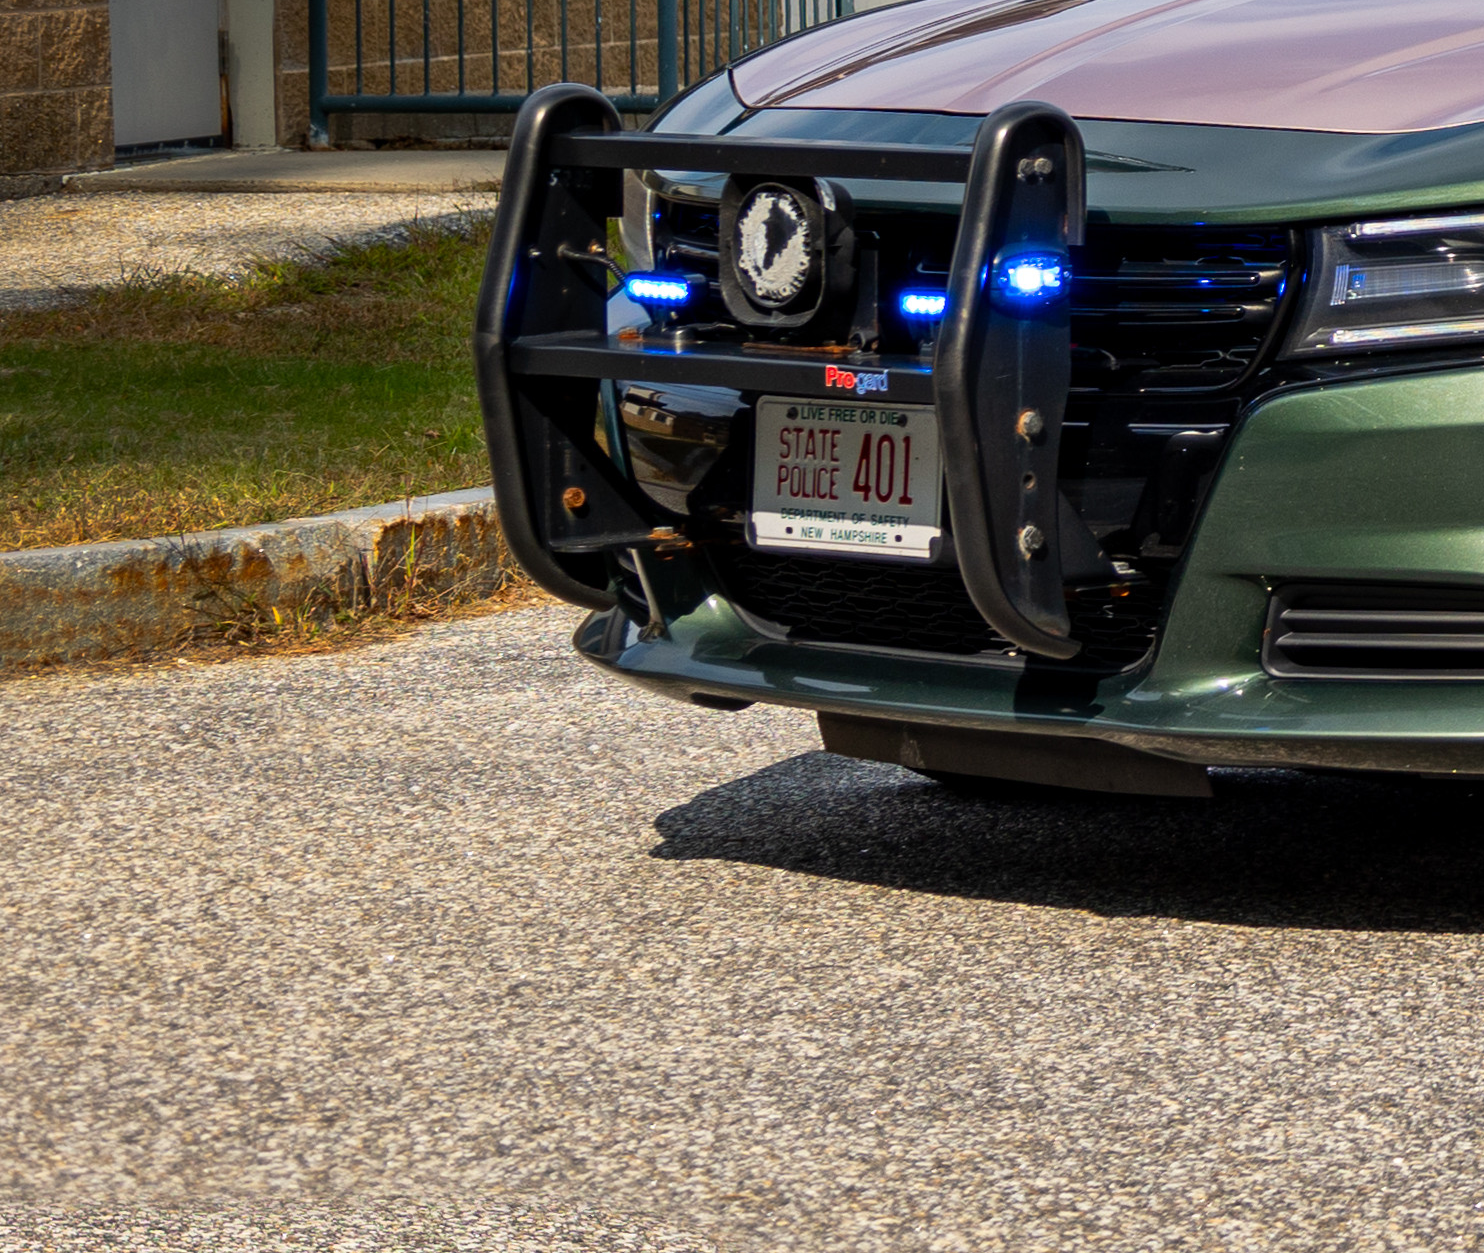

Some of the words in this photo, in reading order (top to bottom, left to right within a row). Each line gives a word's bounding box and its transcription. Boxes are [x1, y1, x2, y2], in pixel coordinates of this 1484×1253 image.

[801, 407, 825, 420] LIVE
[827, 408, 856, 423] FREE
[860, 410, 876, 424] OR
[879, 411, 899, 425] DIE
[779, 427, 841, 462] STATE
[777, 465, 840, 500] POLICE
[852, 433, 913, 505] 401
[781, 508, 845, 524] DEPARTMENT
[852, 513, 866, 525] OF
[872, 514, 910, 528] SAFETY
[801, 526, 823, 539] NEW
[830, 528, 888, 544] HAMPSHIRE
